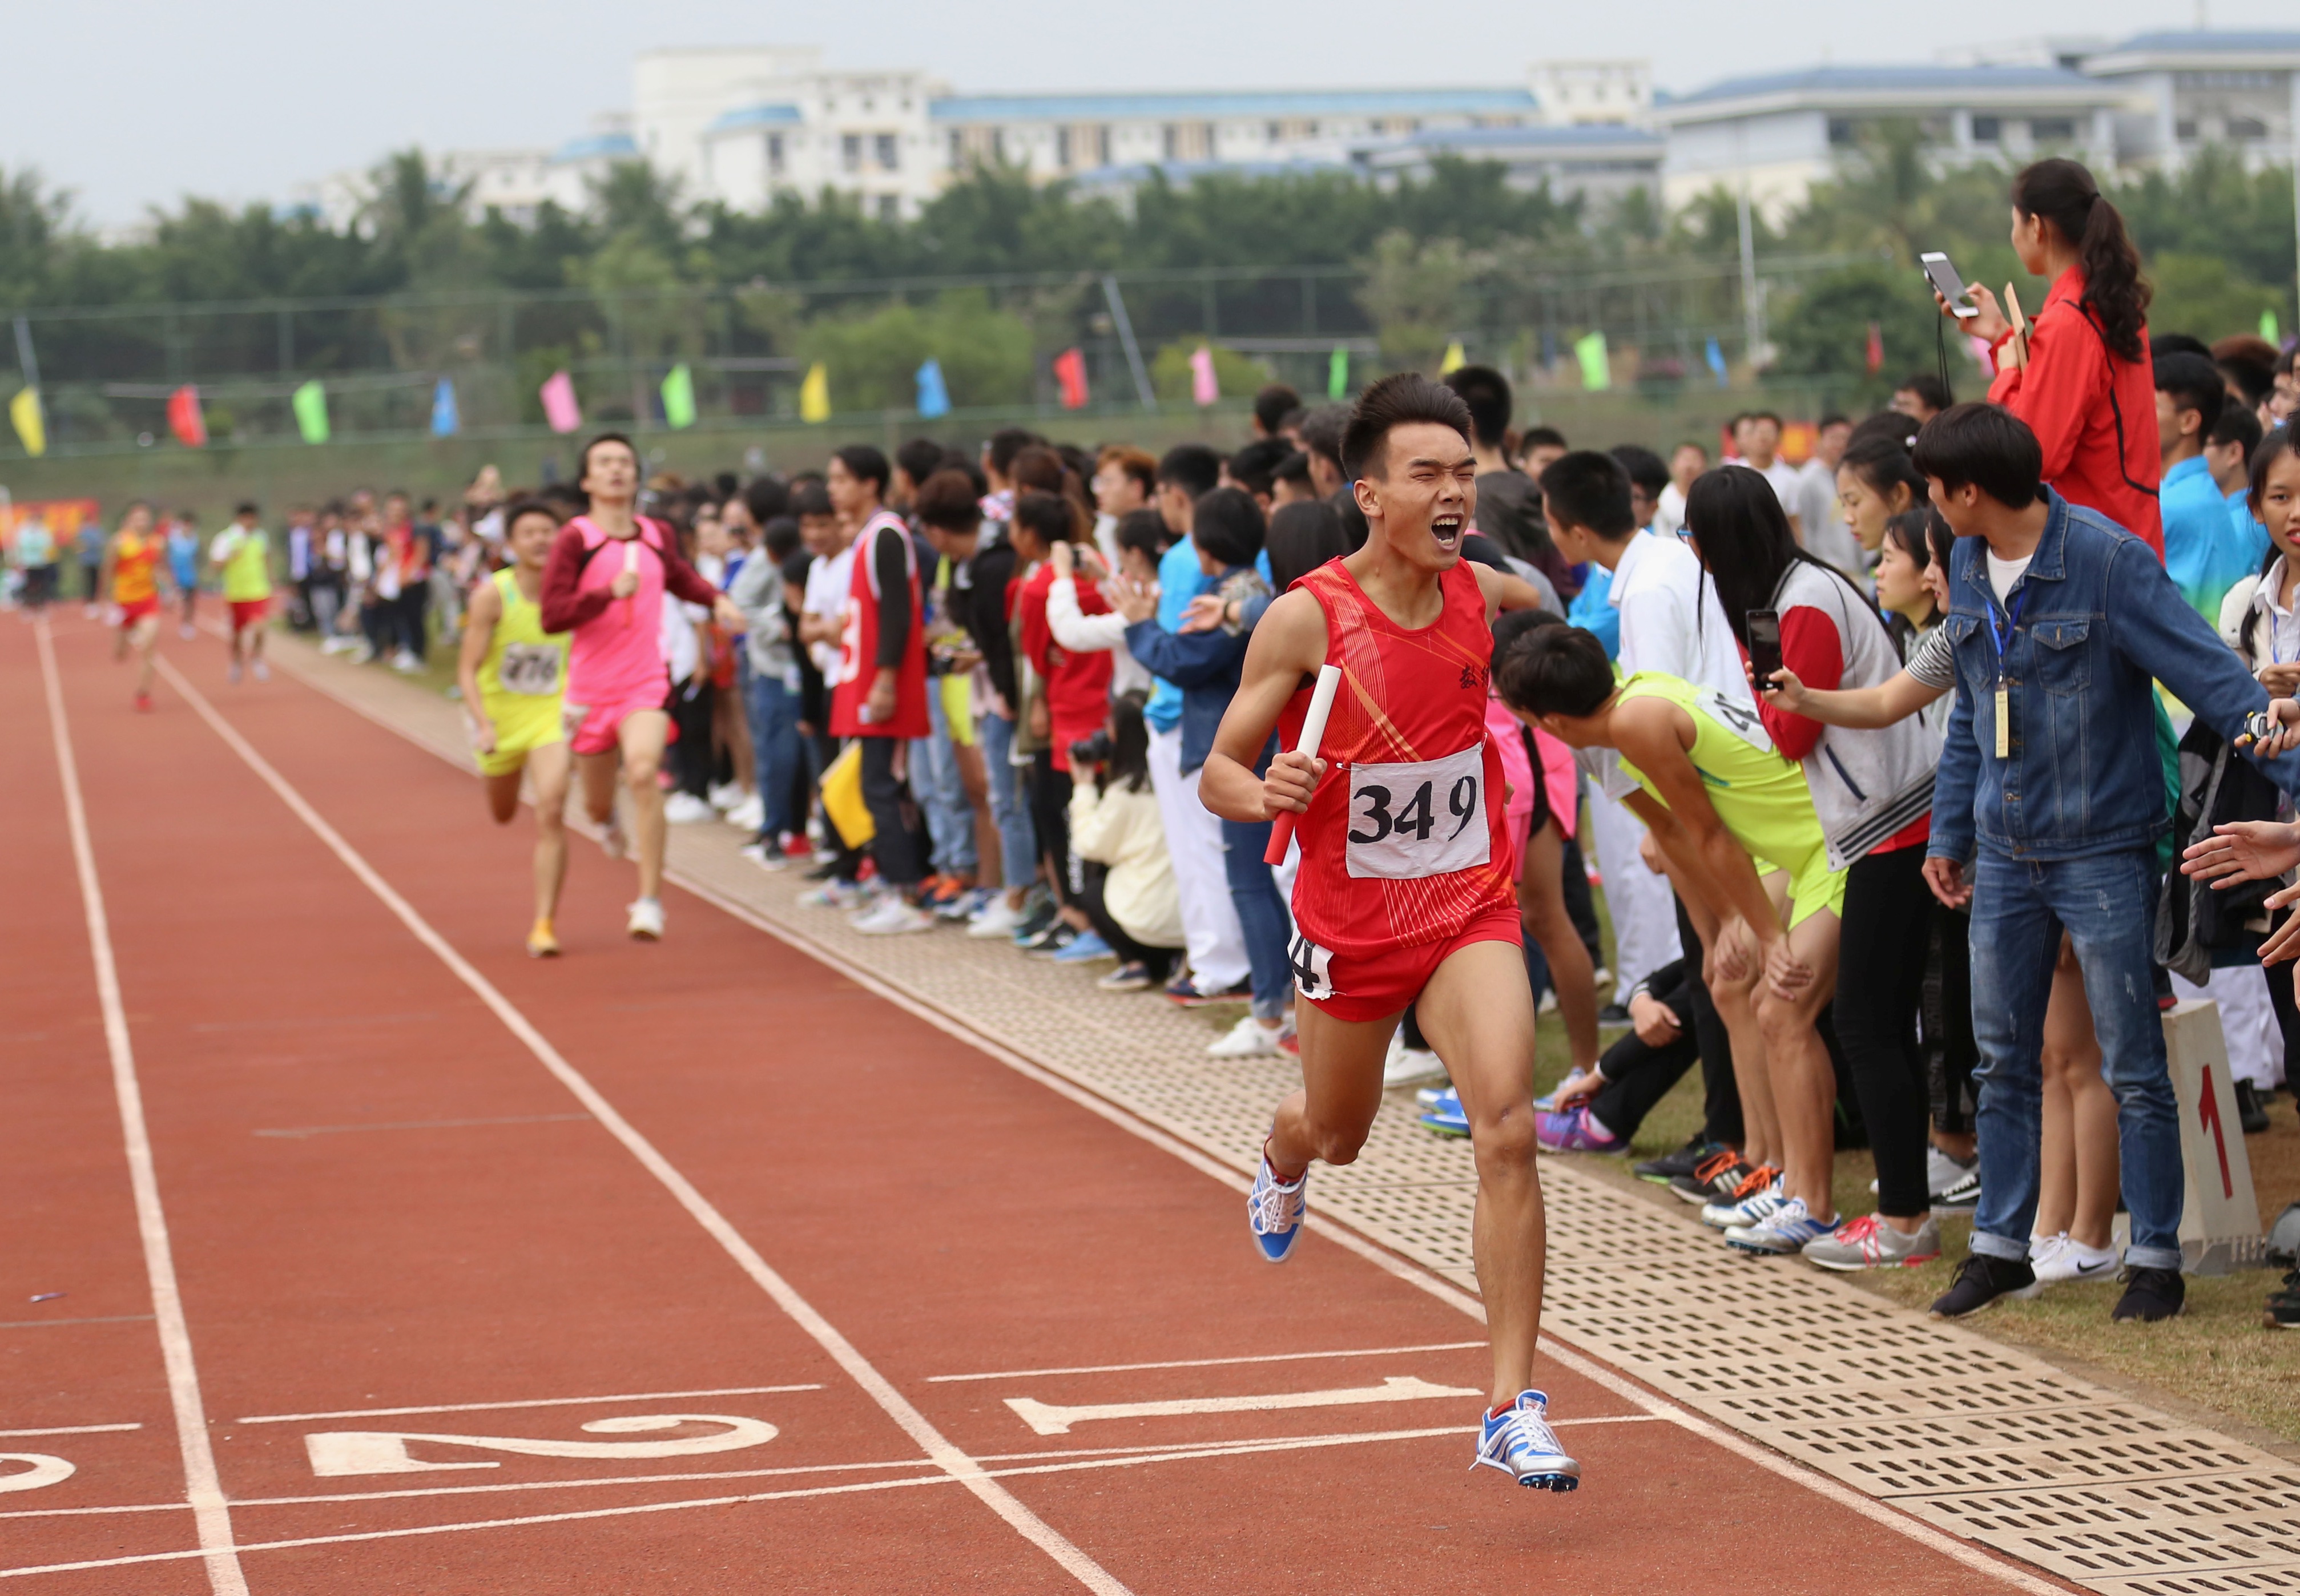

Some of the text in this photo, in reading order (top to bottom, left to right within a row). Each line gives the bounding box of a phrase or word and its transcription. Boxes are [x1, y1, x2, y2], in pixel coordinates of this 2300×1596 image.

[1348, 775, 1477, 844] 349
[2198, 1063, 2233, 1200] 1
[1003, 1376, 1485, 1436] 1
[305, 1414, 779, 1476] 2
